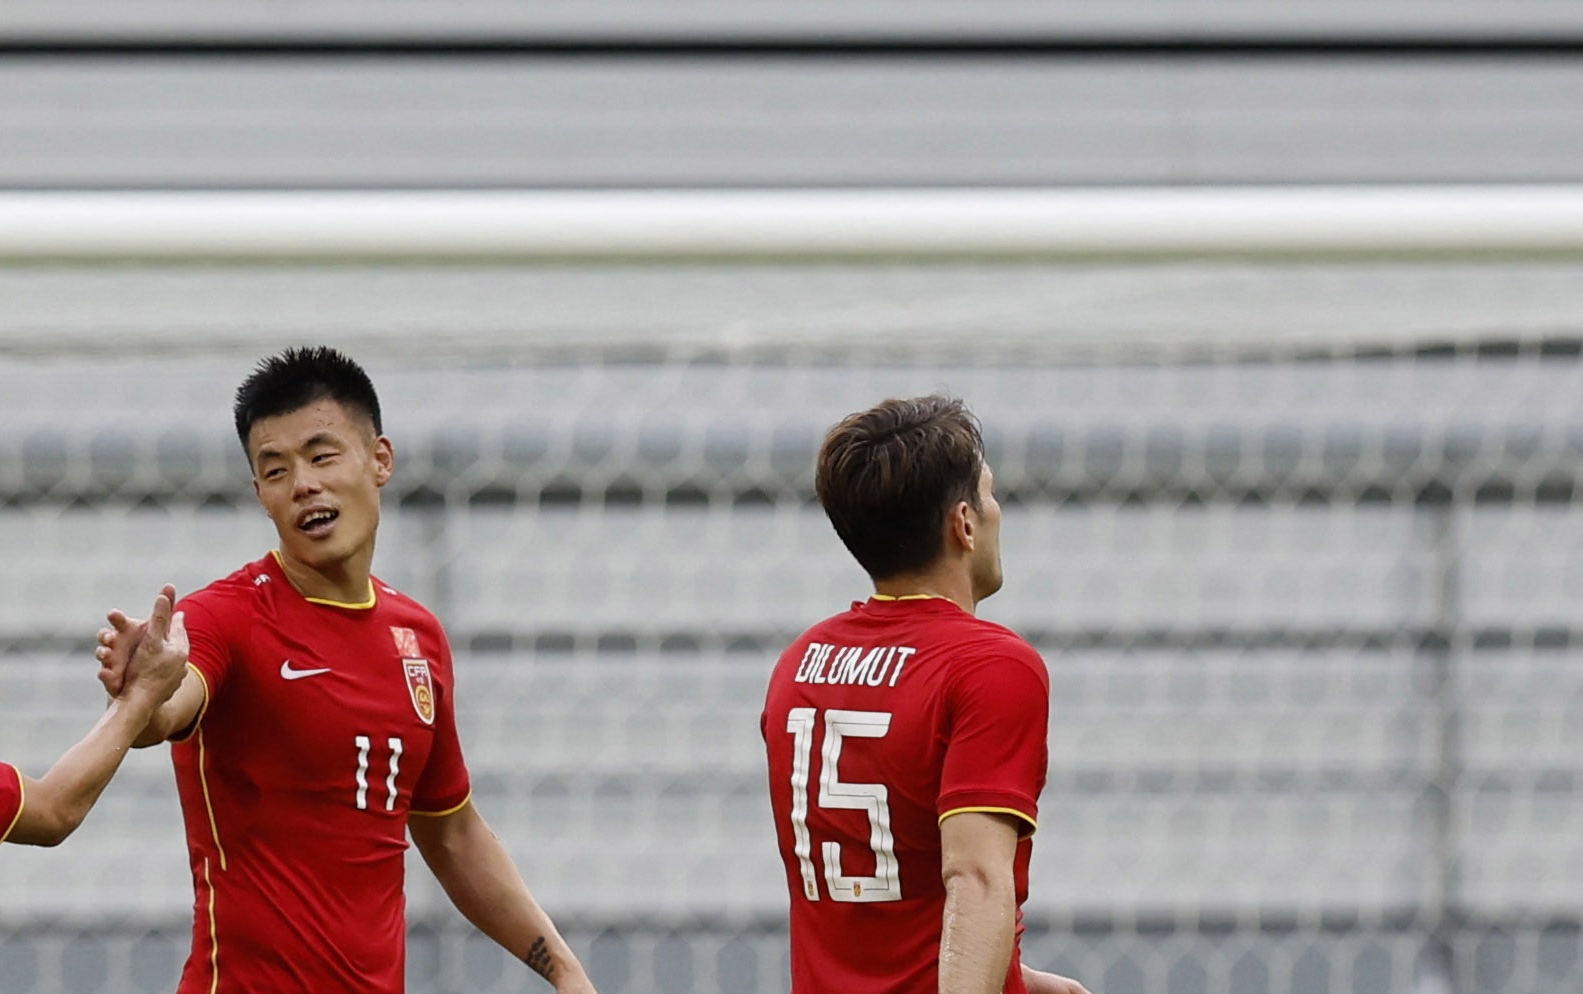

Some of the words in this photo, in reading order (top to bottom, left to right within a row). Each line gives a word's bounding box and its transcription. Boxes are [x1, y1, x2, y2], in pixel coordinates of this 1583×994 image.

[794, 643, 917, 688] DILUMUT
[355, 736, 403, 811] 11
[786, 707, 903, 902] 15
